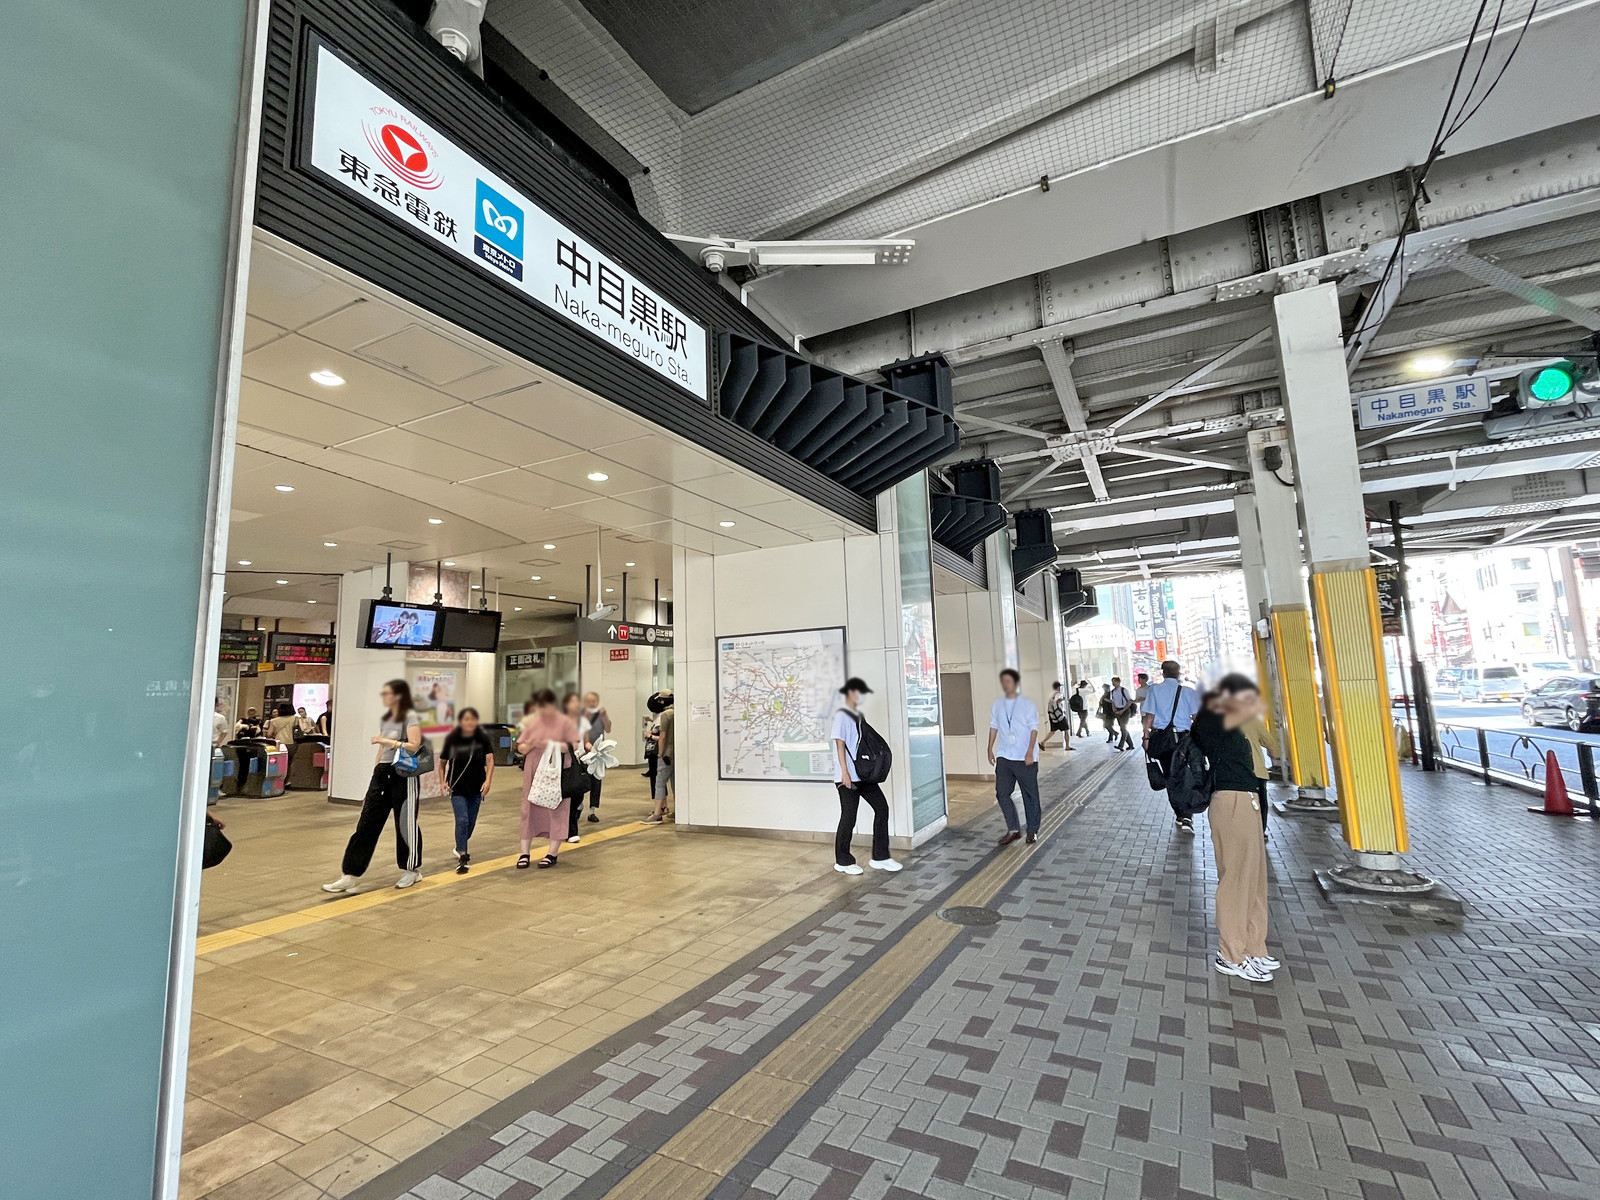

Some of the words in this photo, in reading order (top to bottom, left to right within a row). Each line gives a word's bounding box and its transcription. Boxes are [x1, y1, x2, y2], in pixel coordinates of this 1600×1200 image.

[369, 106, 398, 118] TOKYU
[400, 114, 439, 158] RAILWAYS
[338, 148, 458, 243] 東急電鉄
[482, 243, 516, 269] 東京メトロ
[556, 238, 688, 360] 中目黒駅
[555, 283, 664, 367] Naka-meguro
[667, 356, 693, 385] Sta.
[1370, 383, 1478, 413] 中目黒駅
[1377, 404, 1444, 422] Nakameguro
[1452, 400, 1476, 411] Sta.
[1151, 593, 1165, 624] Tomod's
[509, 653, 541, 665] 正面改札
